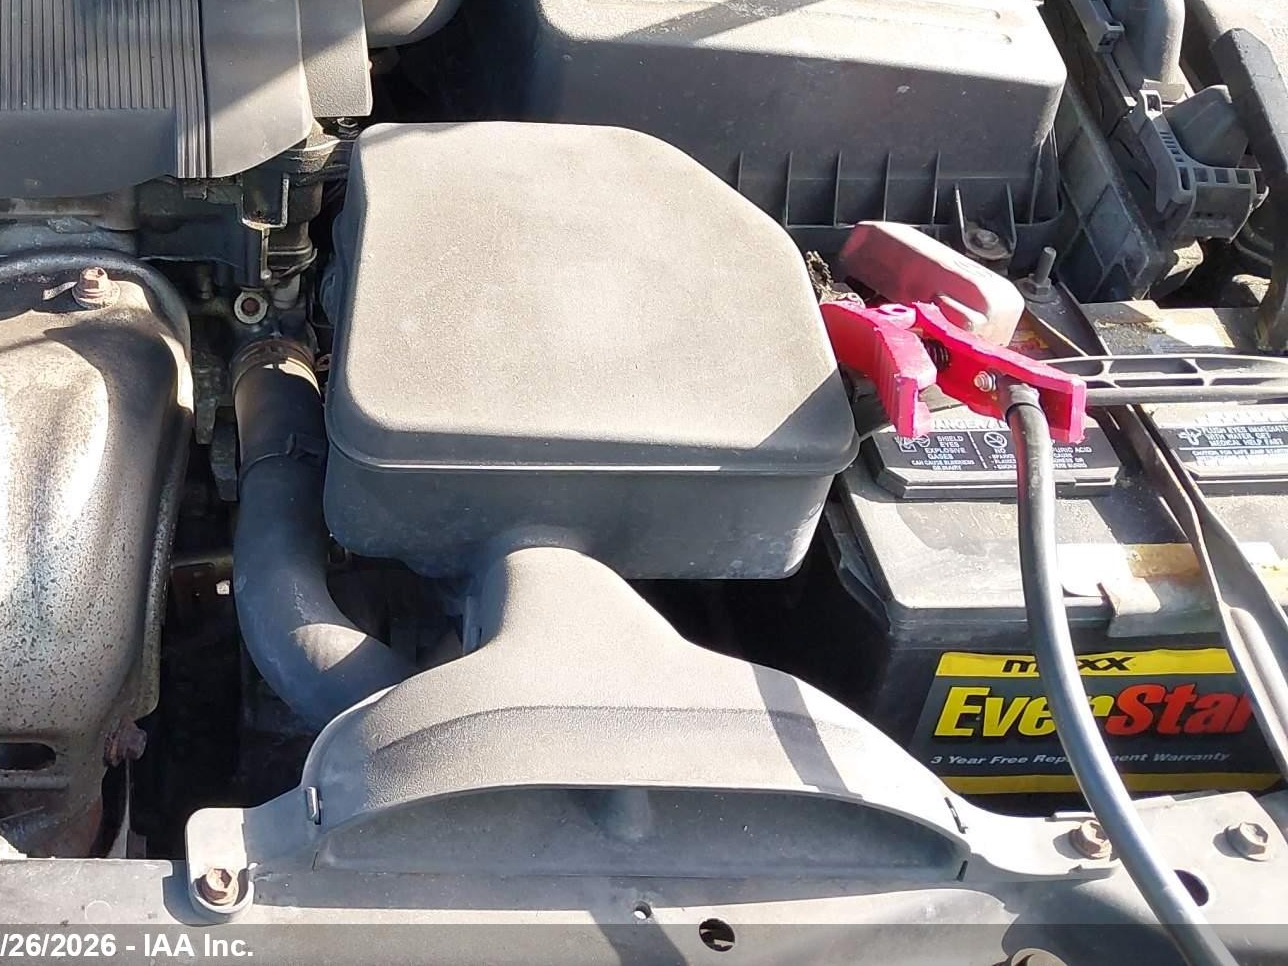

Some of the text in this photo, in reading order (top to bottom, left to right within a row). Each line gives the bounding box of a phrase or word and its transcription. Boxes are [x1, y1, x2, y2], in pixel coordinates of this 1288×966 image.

[1002, 656, 1136, 673] mxx
[930, 755, 942, 765] 3
[946, 755, 985, 765] Year
[989, 755, 1028, 765] Free
[1153, 752, 1231, 765] Warranty
